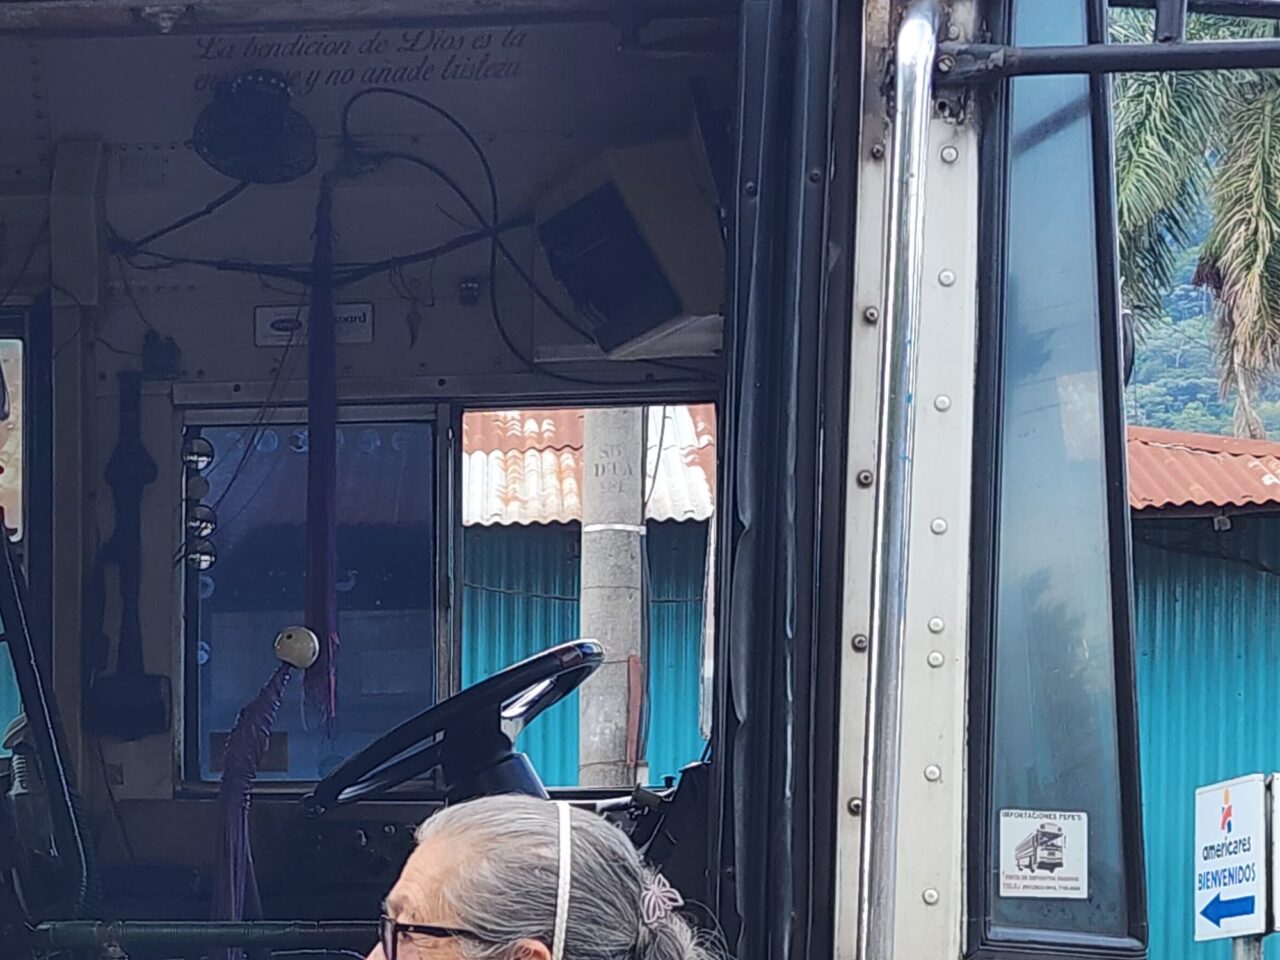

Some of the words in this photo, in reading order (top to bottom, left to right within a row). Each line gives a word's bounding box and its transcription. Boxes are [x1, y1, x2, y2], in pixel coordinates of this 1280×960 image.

[192, 36, 233, 61] La
[243, 33, 351, 57] bendicion
[357, 31, 388, 54] de
[396, 29, 466, 52] Dios
[473, 34, 495, 50] es
[503, 28, 529, 49] la
[324, 66, 355, 86] no
[441, 53, 523, 82] tristeza
[1202, 836, 1252, 861] americares
[1198, 863, 1256, 891] BIENVENIDOS
